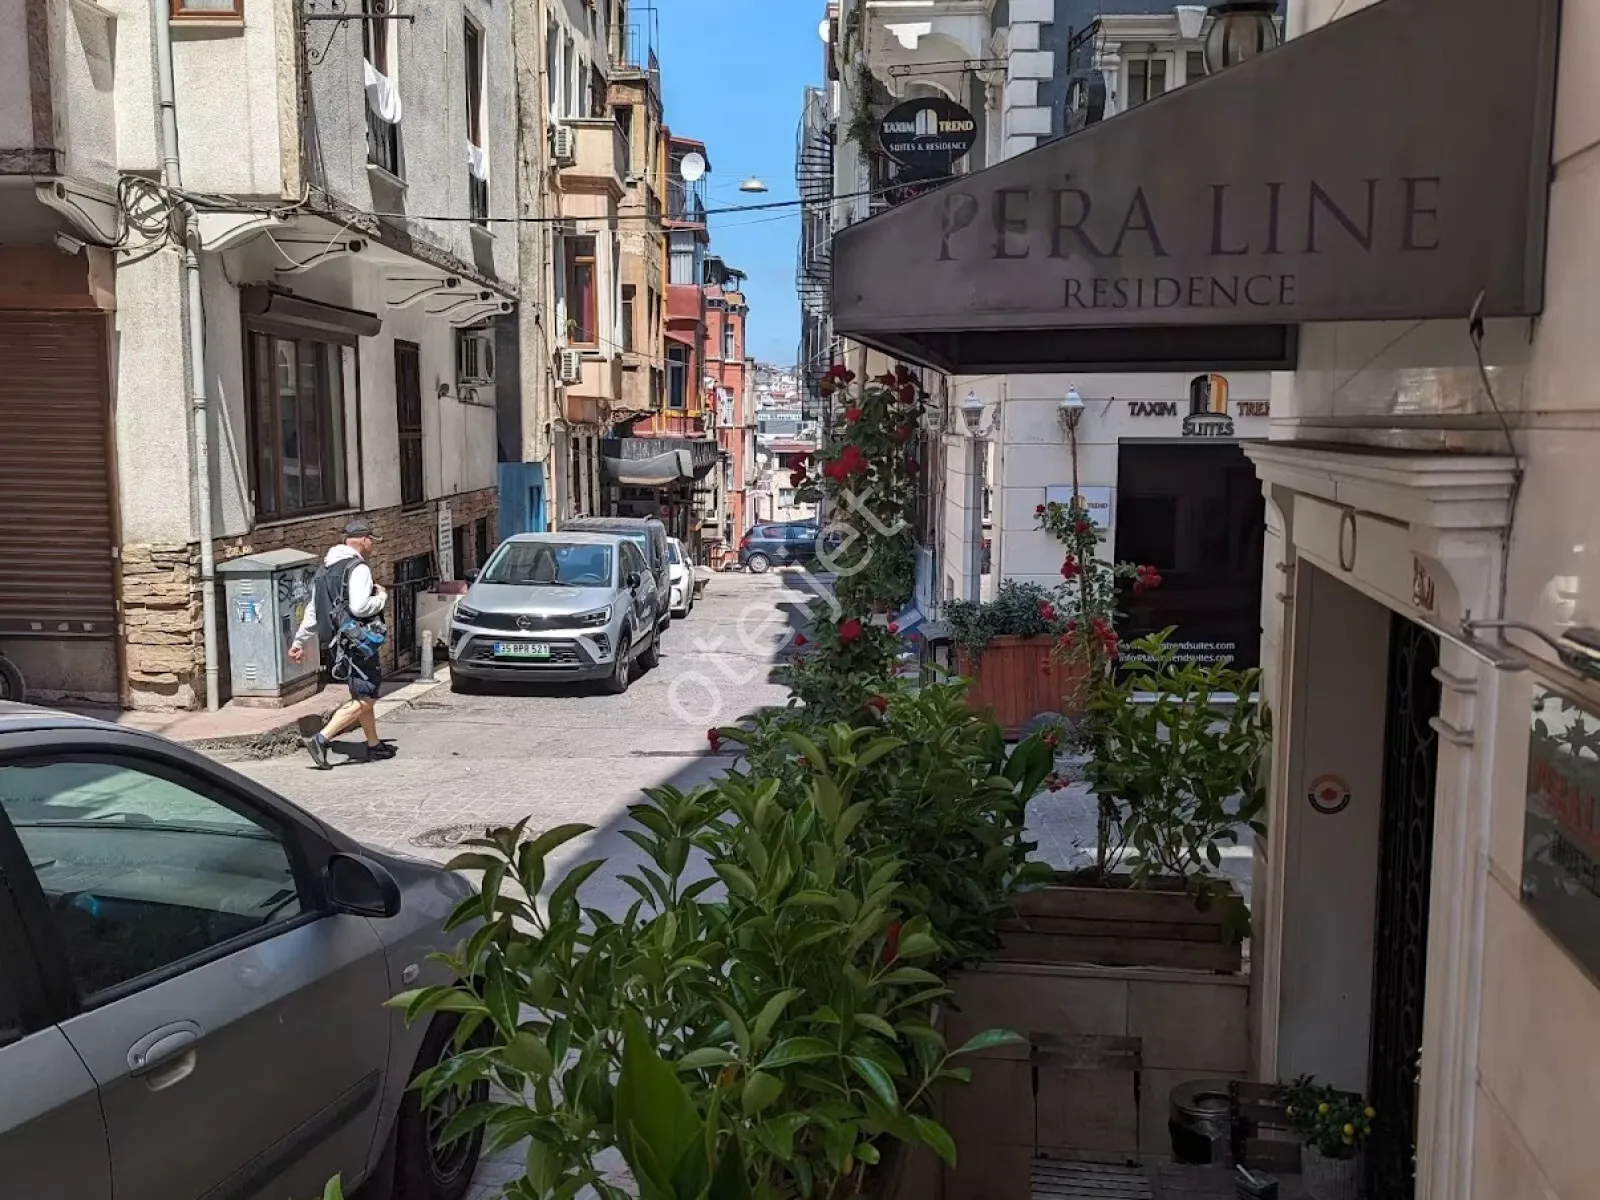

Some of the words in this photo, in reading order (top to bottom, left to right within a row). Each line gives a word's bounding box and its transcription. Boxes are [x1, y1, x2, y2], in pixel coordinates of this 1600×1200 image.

[883, 121, 915, 133] TAXIM
[939, 120, 974, 132] TREND
[889, 143, 916, 151] SUITES
[926, 142, 967, 151] RESIDENCE
[936, 185, 1171, 262] PERA
[1208, 176, 1441, 256] LINE
[1063, 273, 1296, 309] RESIDENCE
[1128, 402, 1177, 416] TAXIM
[1182, 421, 1235, 436] SUITES
